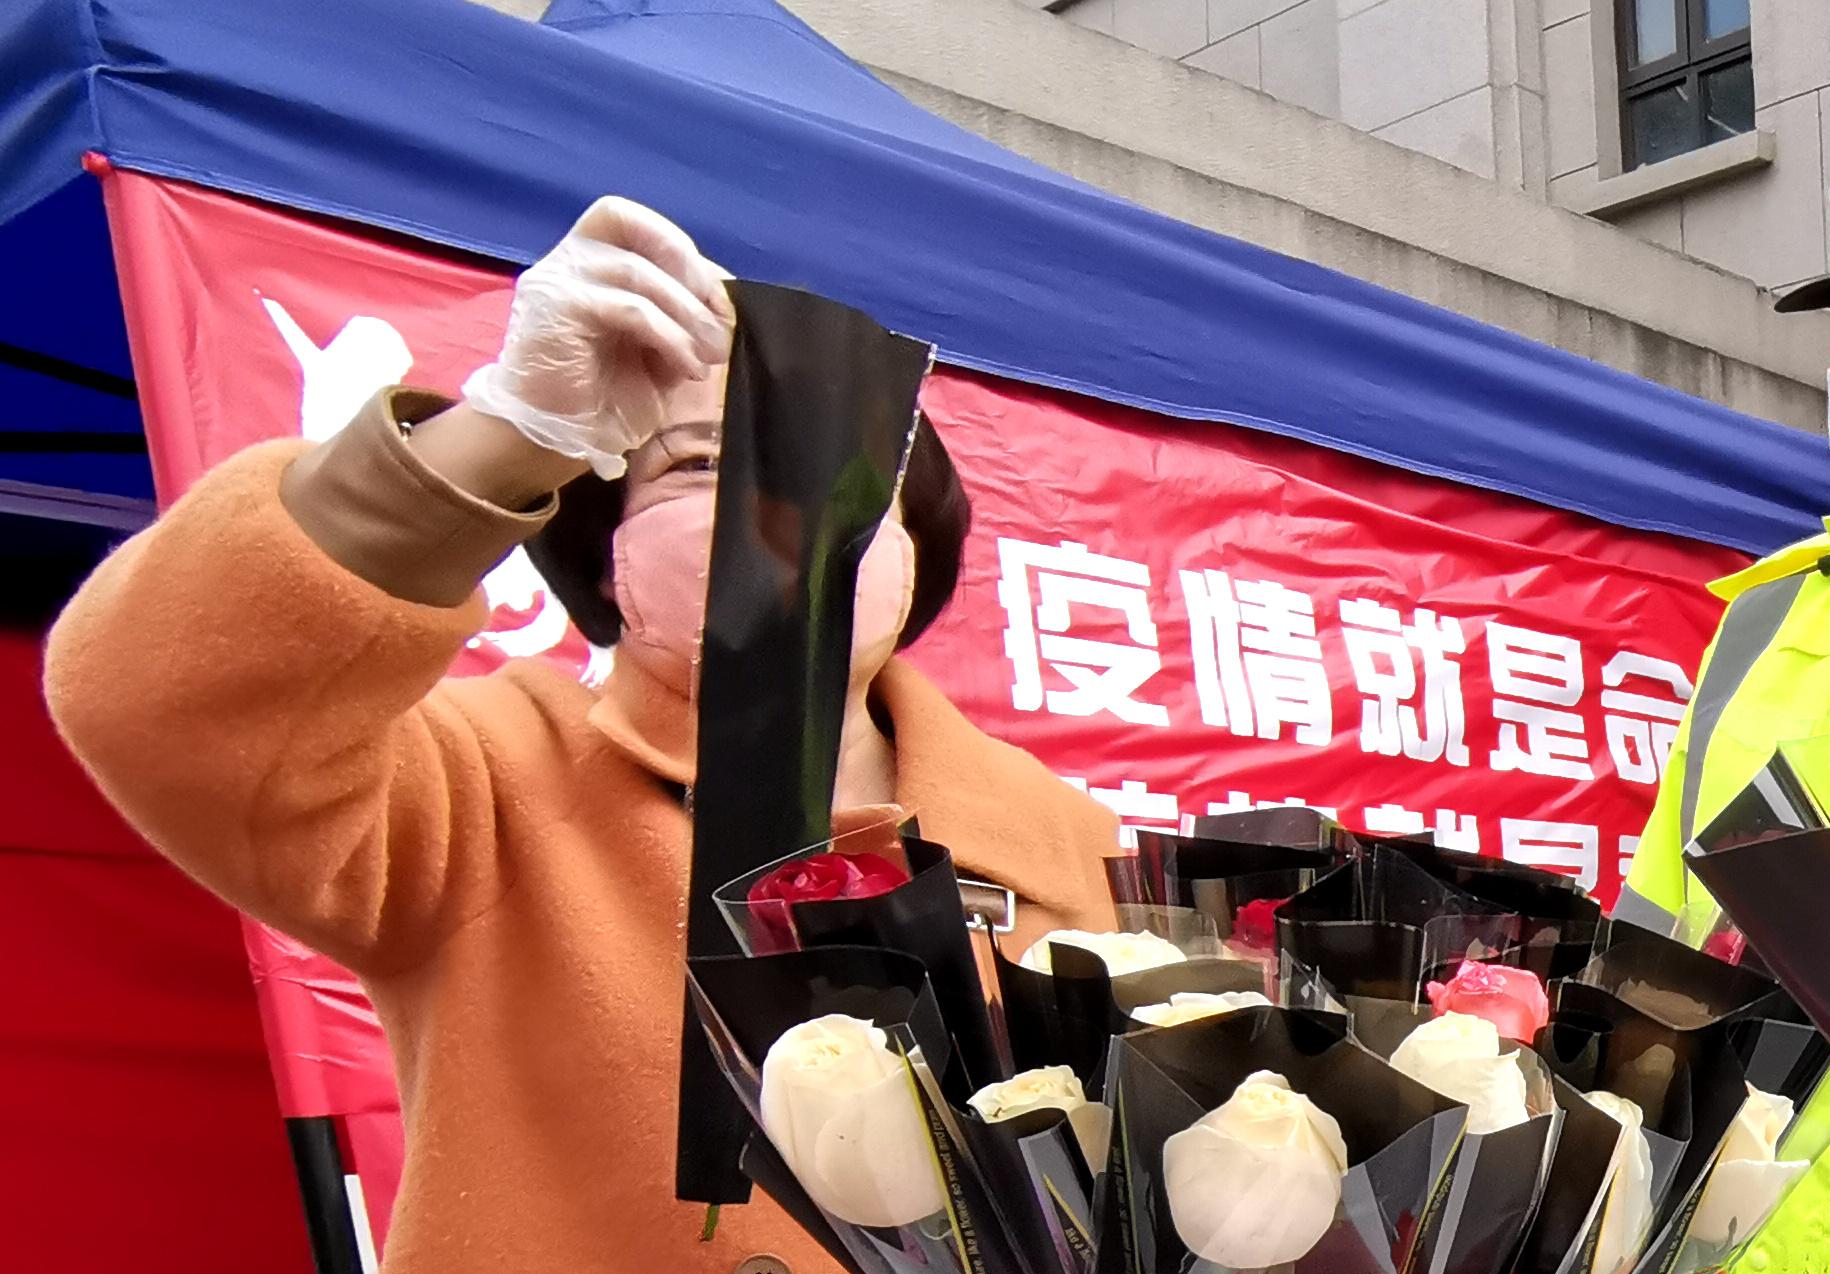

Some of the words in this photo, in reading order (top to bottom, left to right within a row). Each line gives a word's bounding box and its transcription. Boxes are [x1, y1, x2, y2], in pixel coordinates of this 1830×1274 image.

[997, 537, 1693, 784] 疫情就是命
